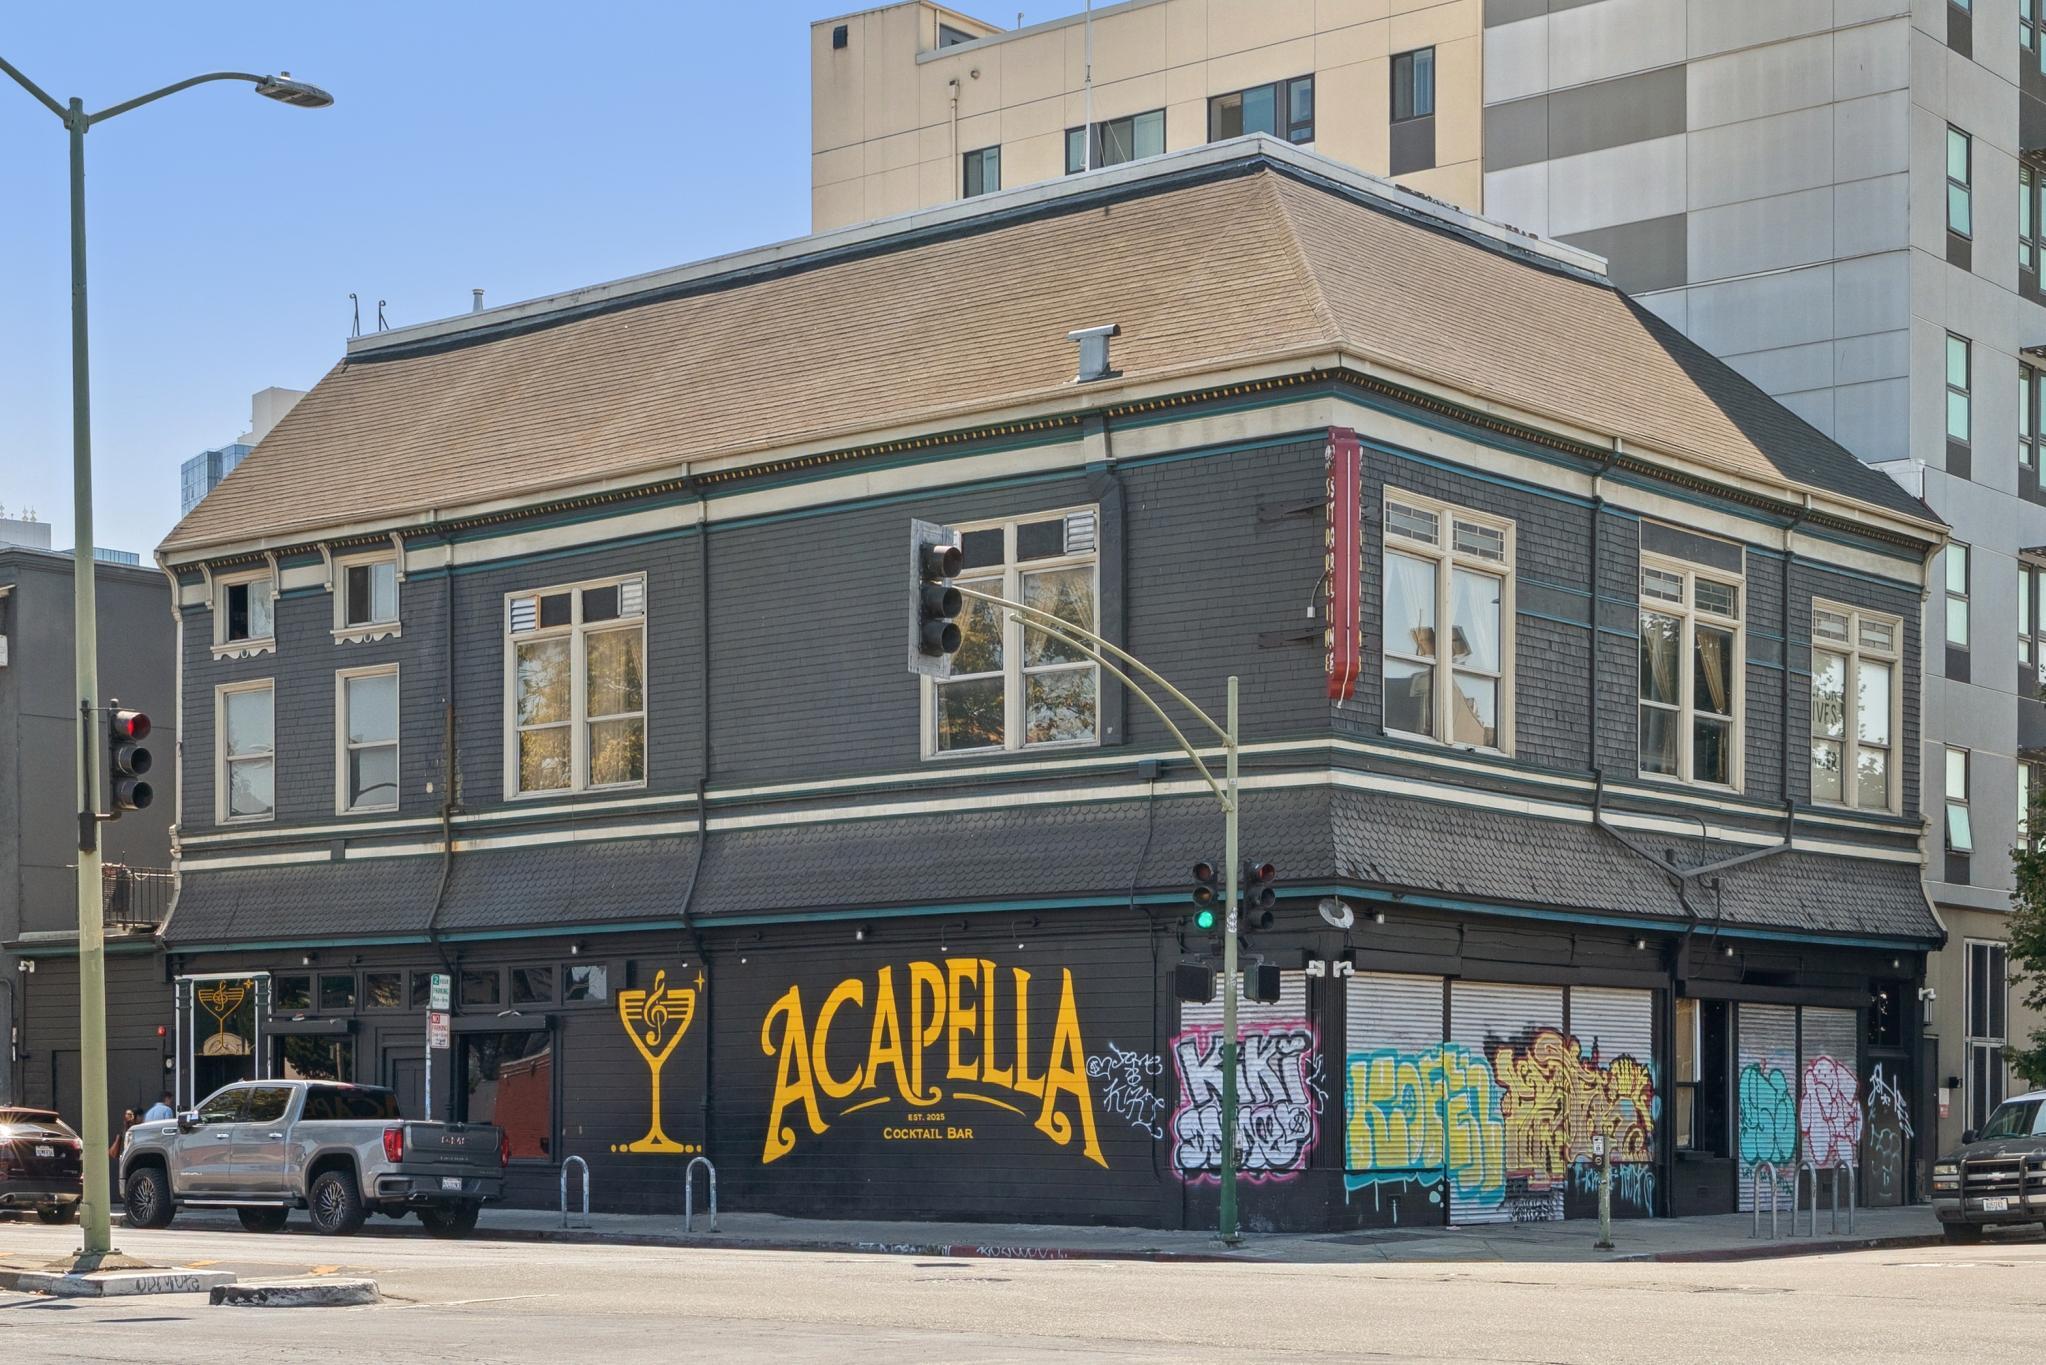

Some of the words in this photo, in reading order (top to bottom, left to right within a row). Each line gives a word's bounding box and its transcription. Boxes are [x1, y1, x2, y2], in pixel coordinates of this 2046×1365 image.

[760, 957, 1109, 1168] ACAPELLA
[908, 1113, 925, 1121] EST.
[926, 1113, 945, 1121] 2025
[883, 1127, 943, 1139] COCKTAIL
[947, 1127, 974, 1139] BAR
